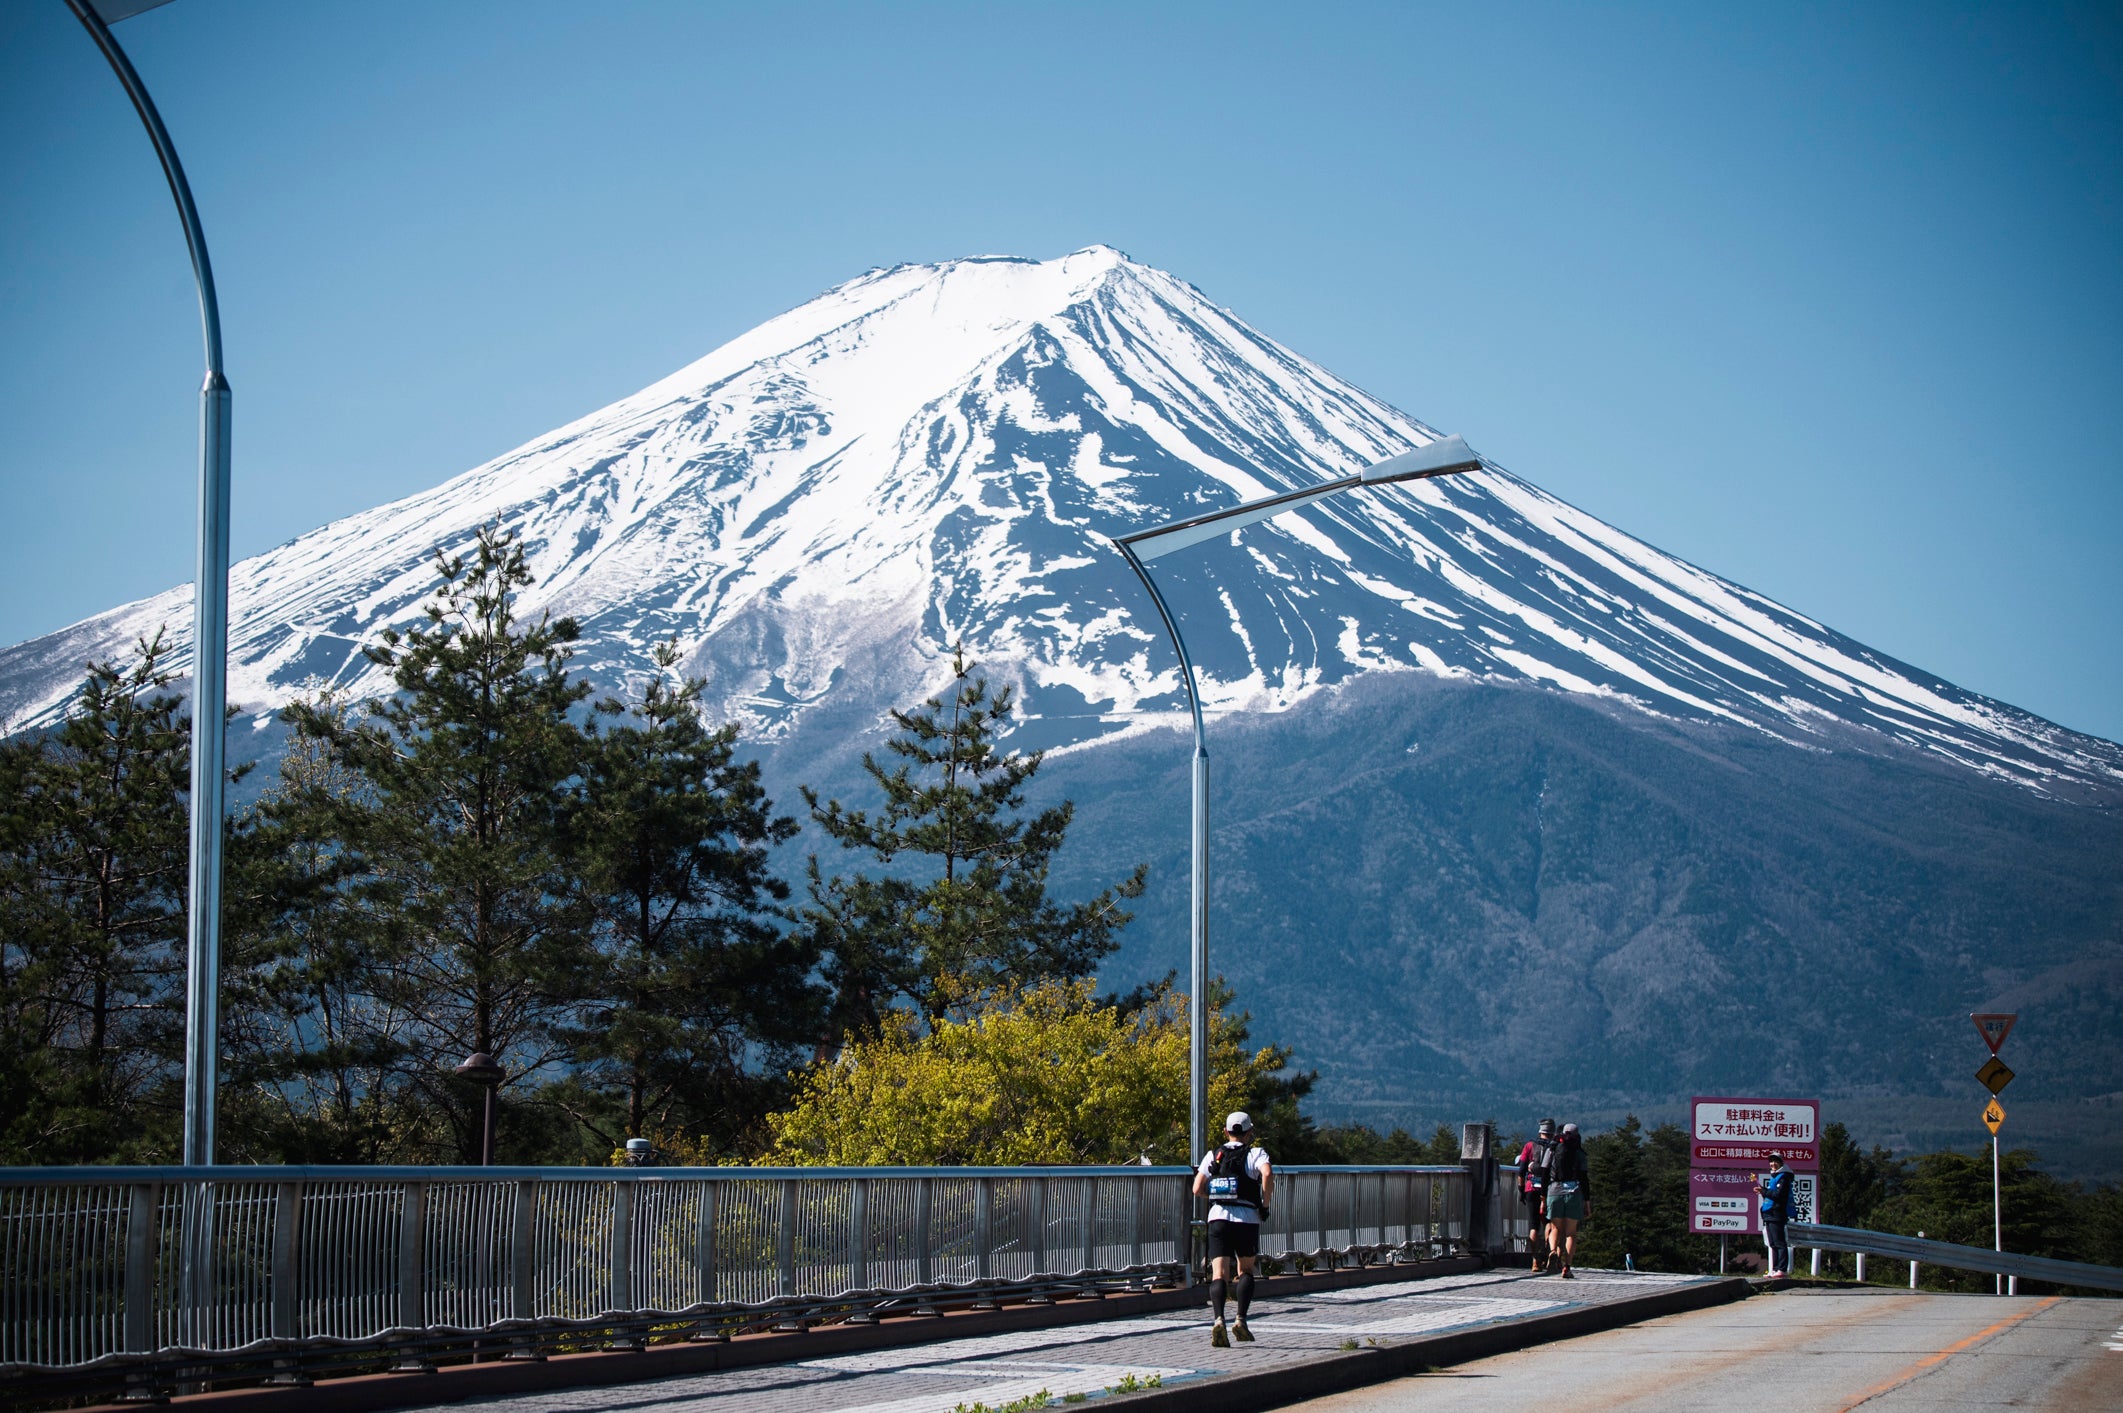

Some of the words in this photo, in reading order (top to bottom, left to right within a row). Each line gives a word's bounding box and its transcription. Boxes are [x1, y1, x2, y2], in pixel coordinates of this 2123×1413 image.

[1726, 1109, 1785, 1121] 駐車料金は
[1713, 1219, 1739, 1228] PayPay
